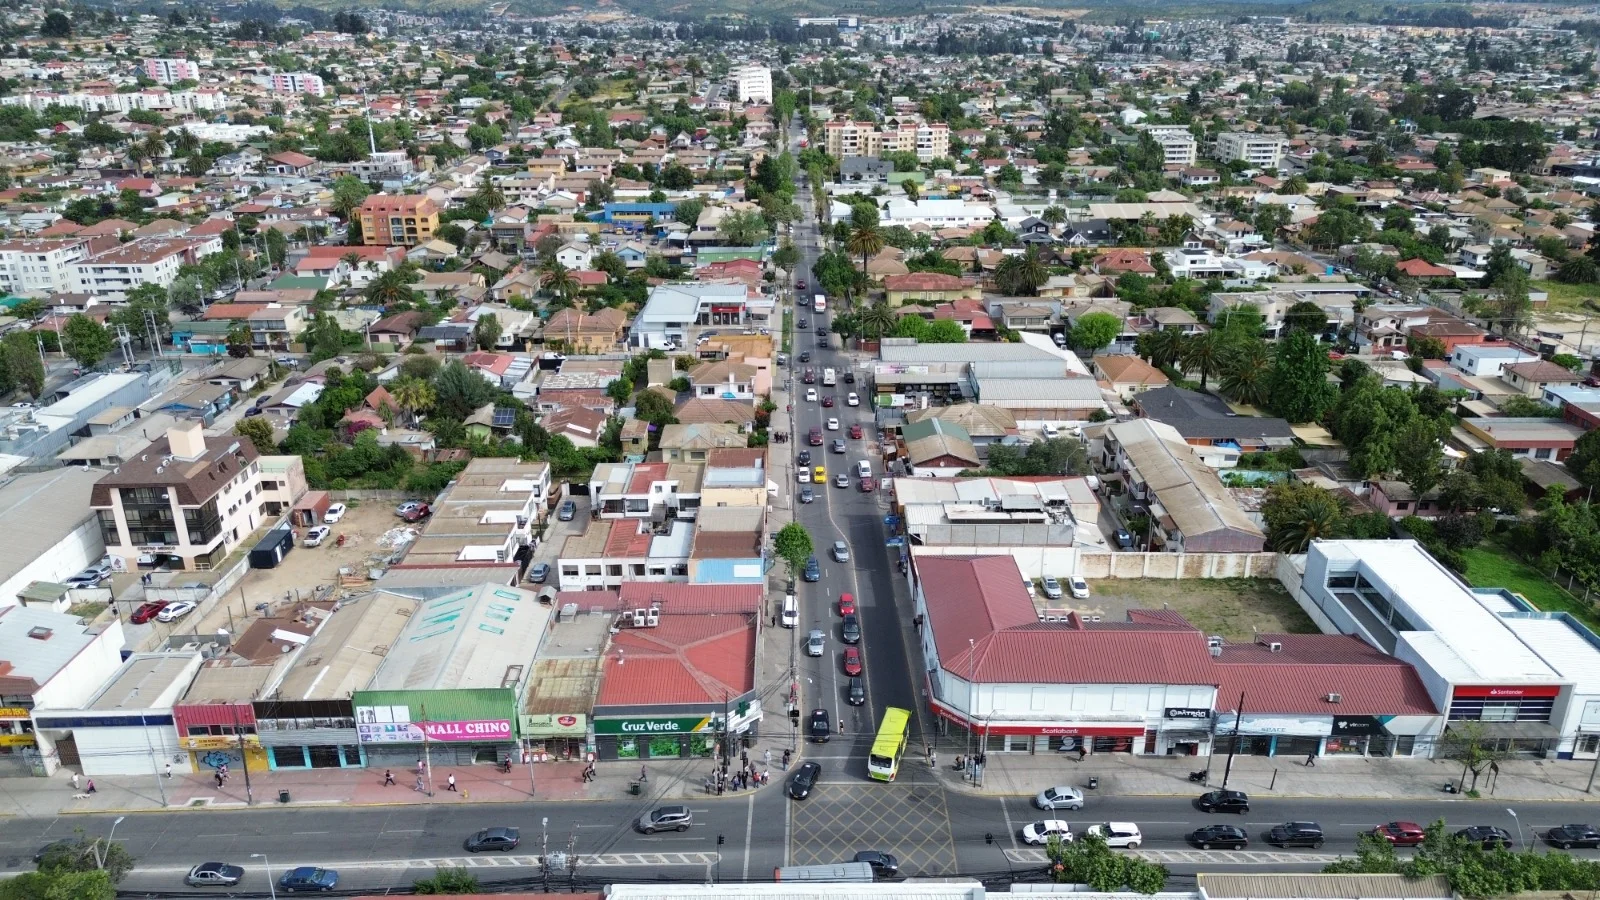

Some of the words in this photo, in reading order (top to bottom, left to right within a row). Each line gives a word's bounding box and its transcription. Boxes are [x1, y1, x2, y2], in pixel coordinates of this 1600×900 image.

[426, 723, 463, 735] MALL
[465, 722, 510, 733] CHINO
[621, 721, 646, 731] Cruz
[646, 720, 679, 731] Verde
